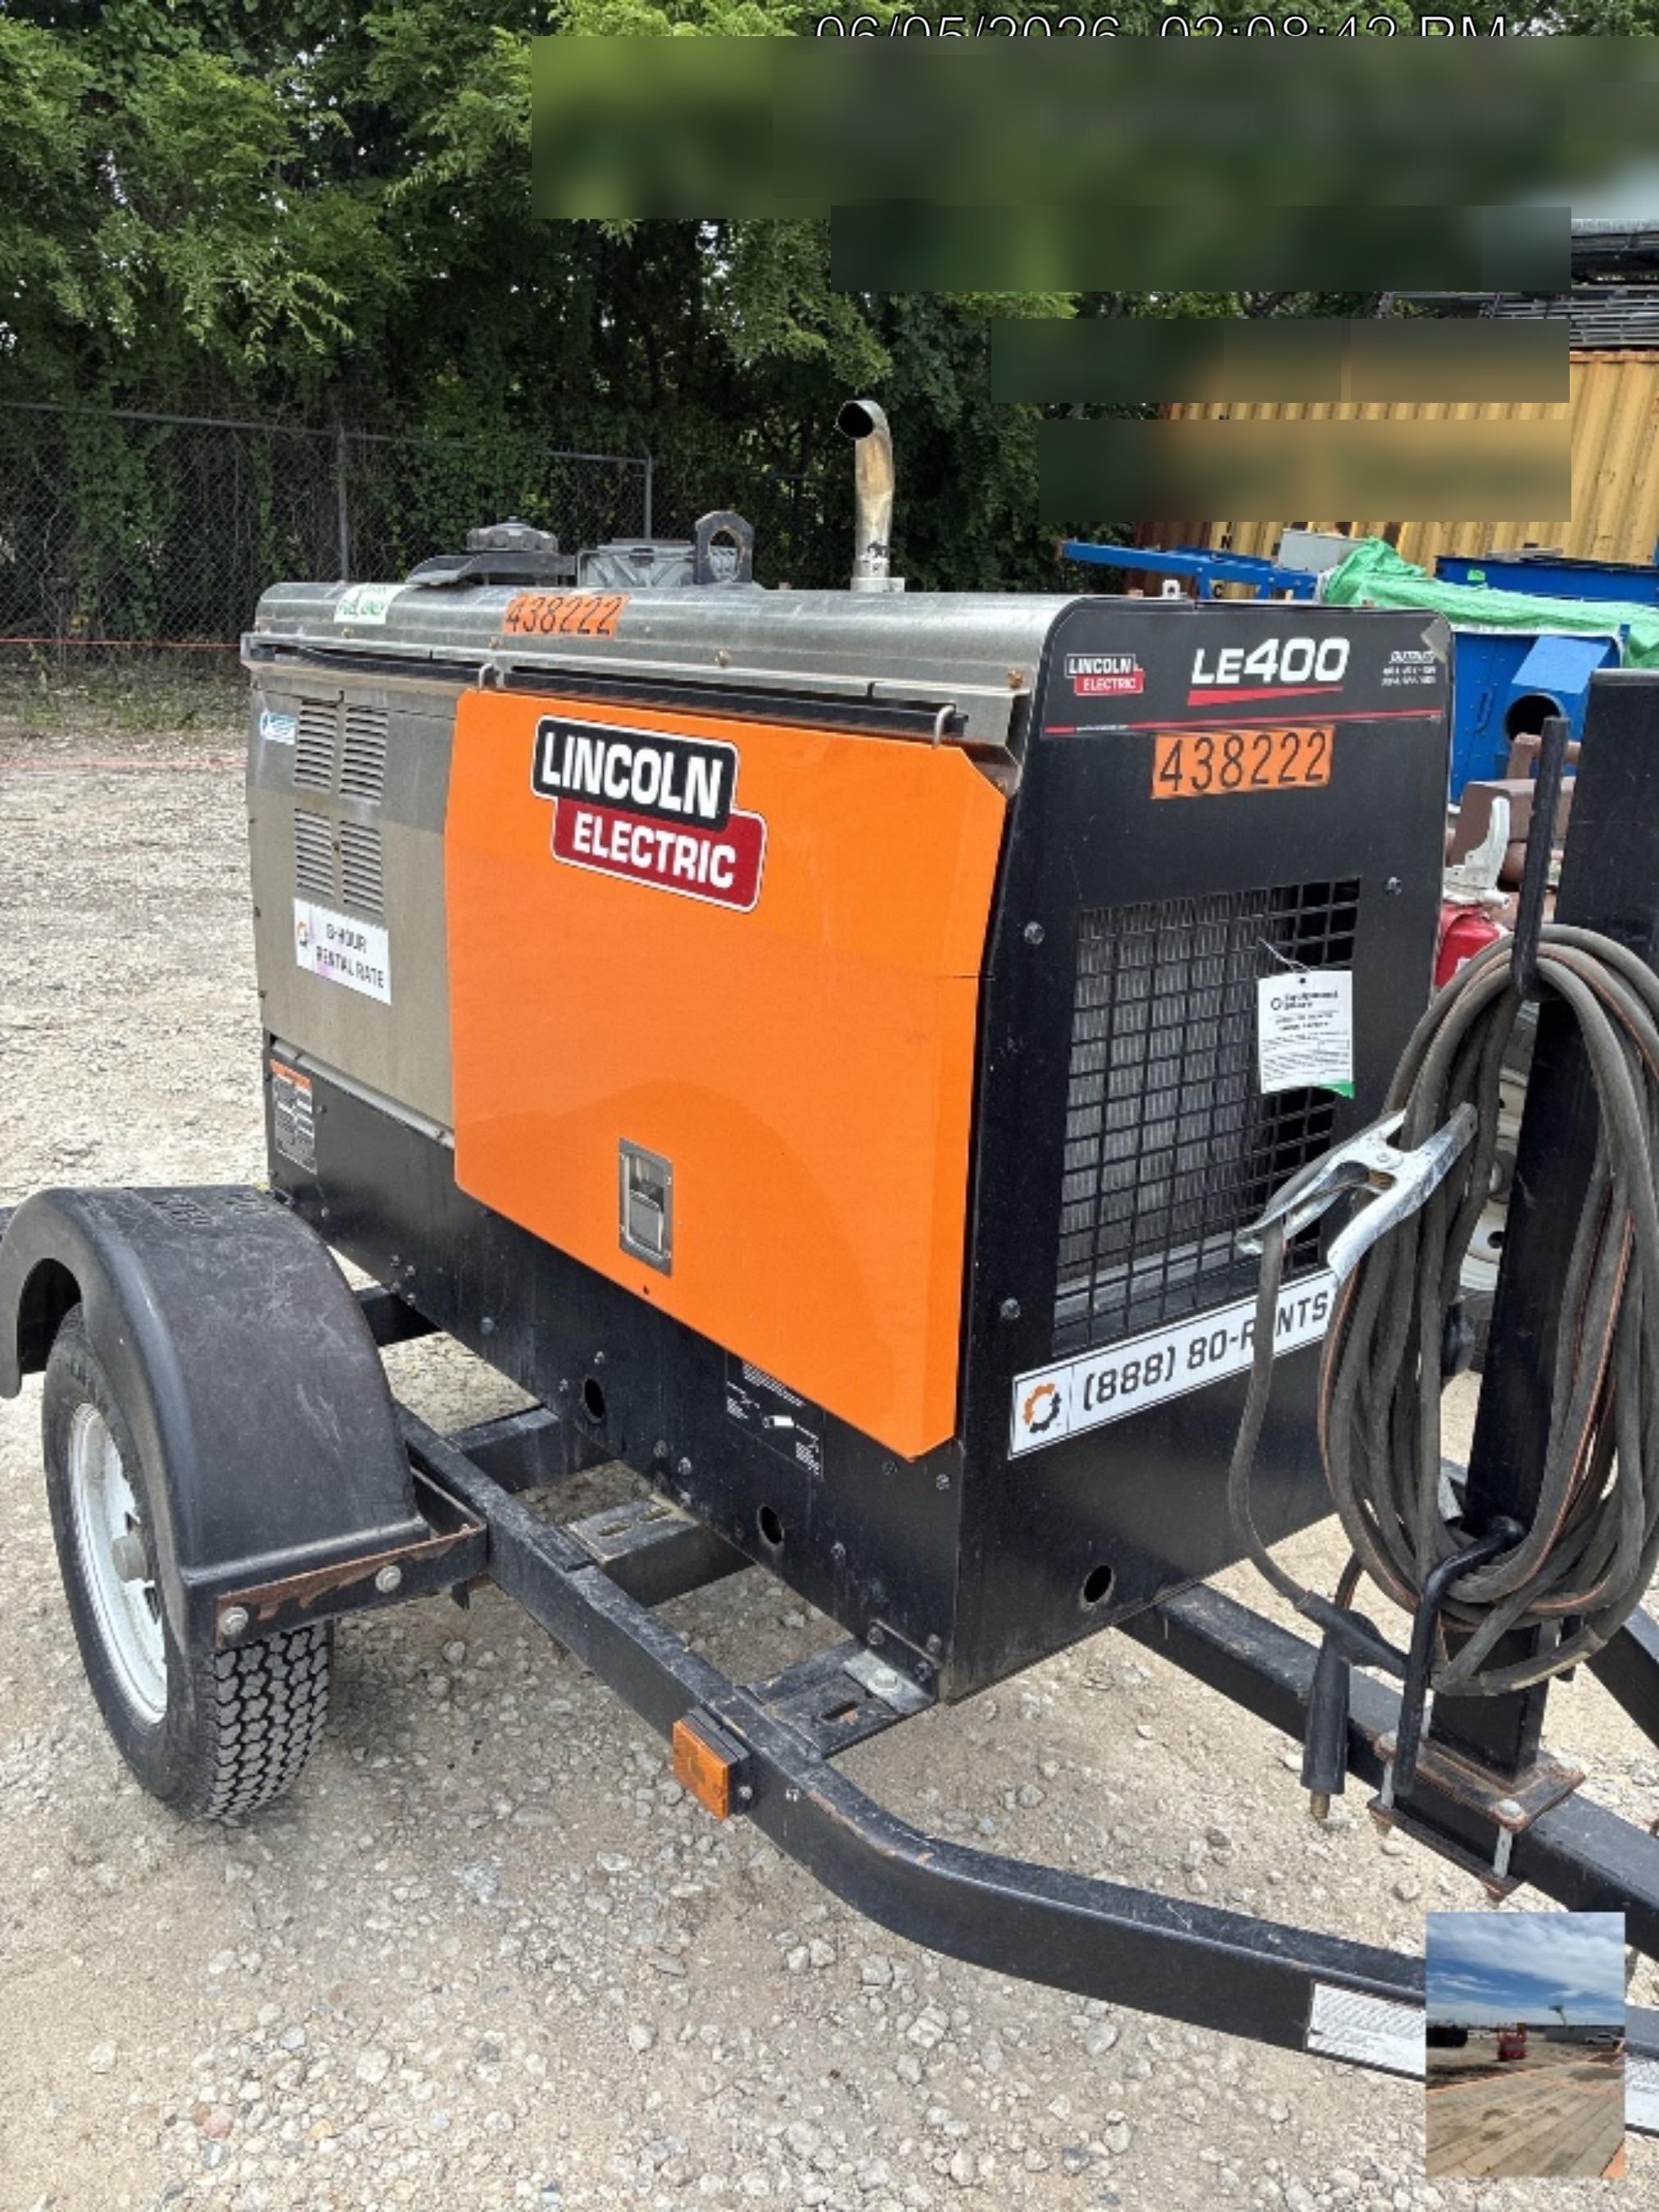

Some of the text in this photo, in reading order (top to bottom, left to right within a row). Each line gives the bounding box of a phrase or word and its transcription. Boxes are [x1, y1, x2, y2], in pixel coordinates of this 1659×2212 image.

[505, 596, 623, 635] 438222
[1068, 658, 1131, 674] LINCOLN
[1083, 678, 1136, 691] ELECTRIC
[1191, 638, 1350, 685] LE400
[541, 732, 723, 819] LINCOLN
[1159, 731, 1327, 791] 438222
[573, 810, 736, 889] ELECTRIC
[356, 960, 384, 989] RATE
[1083, 1290, 1328, 1411] (888) 80-RNTS
